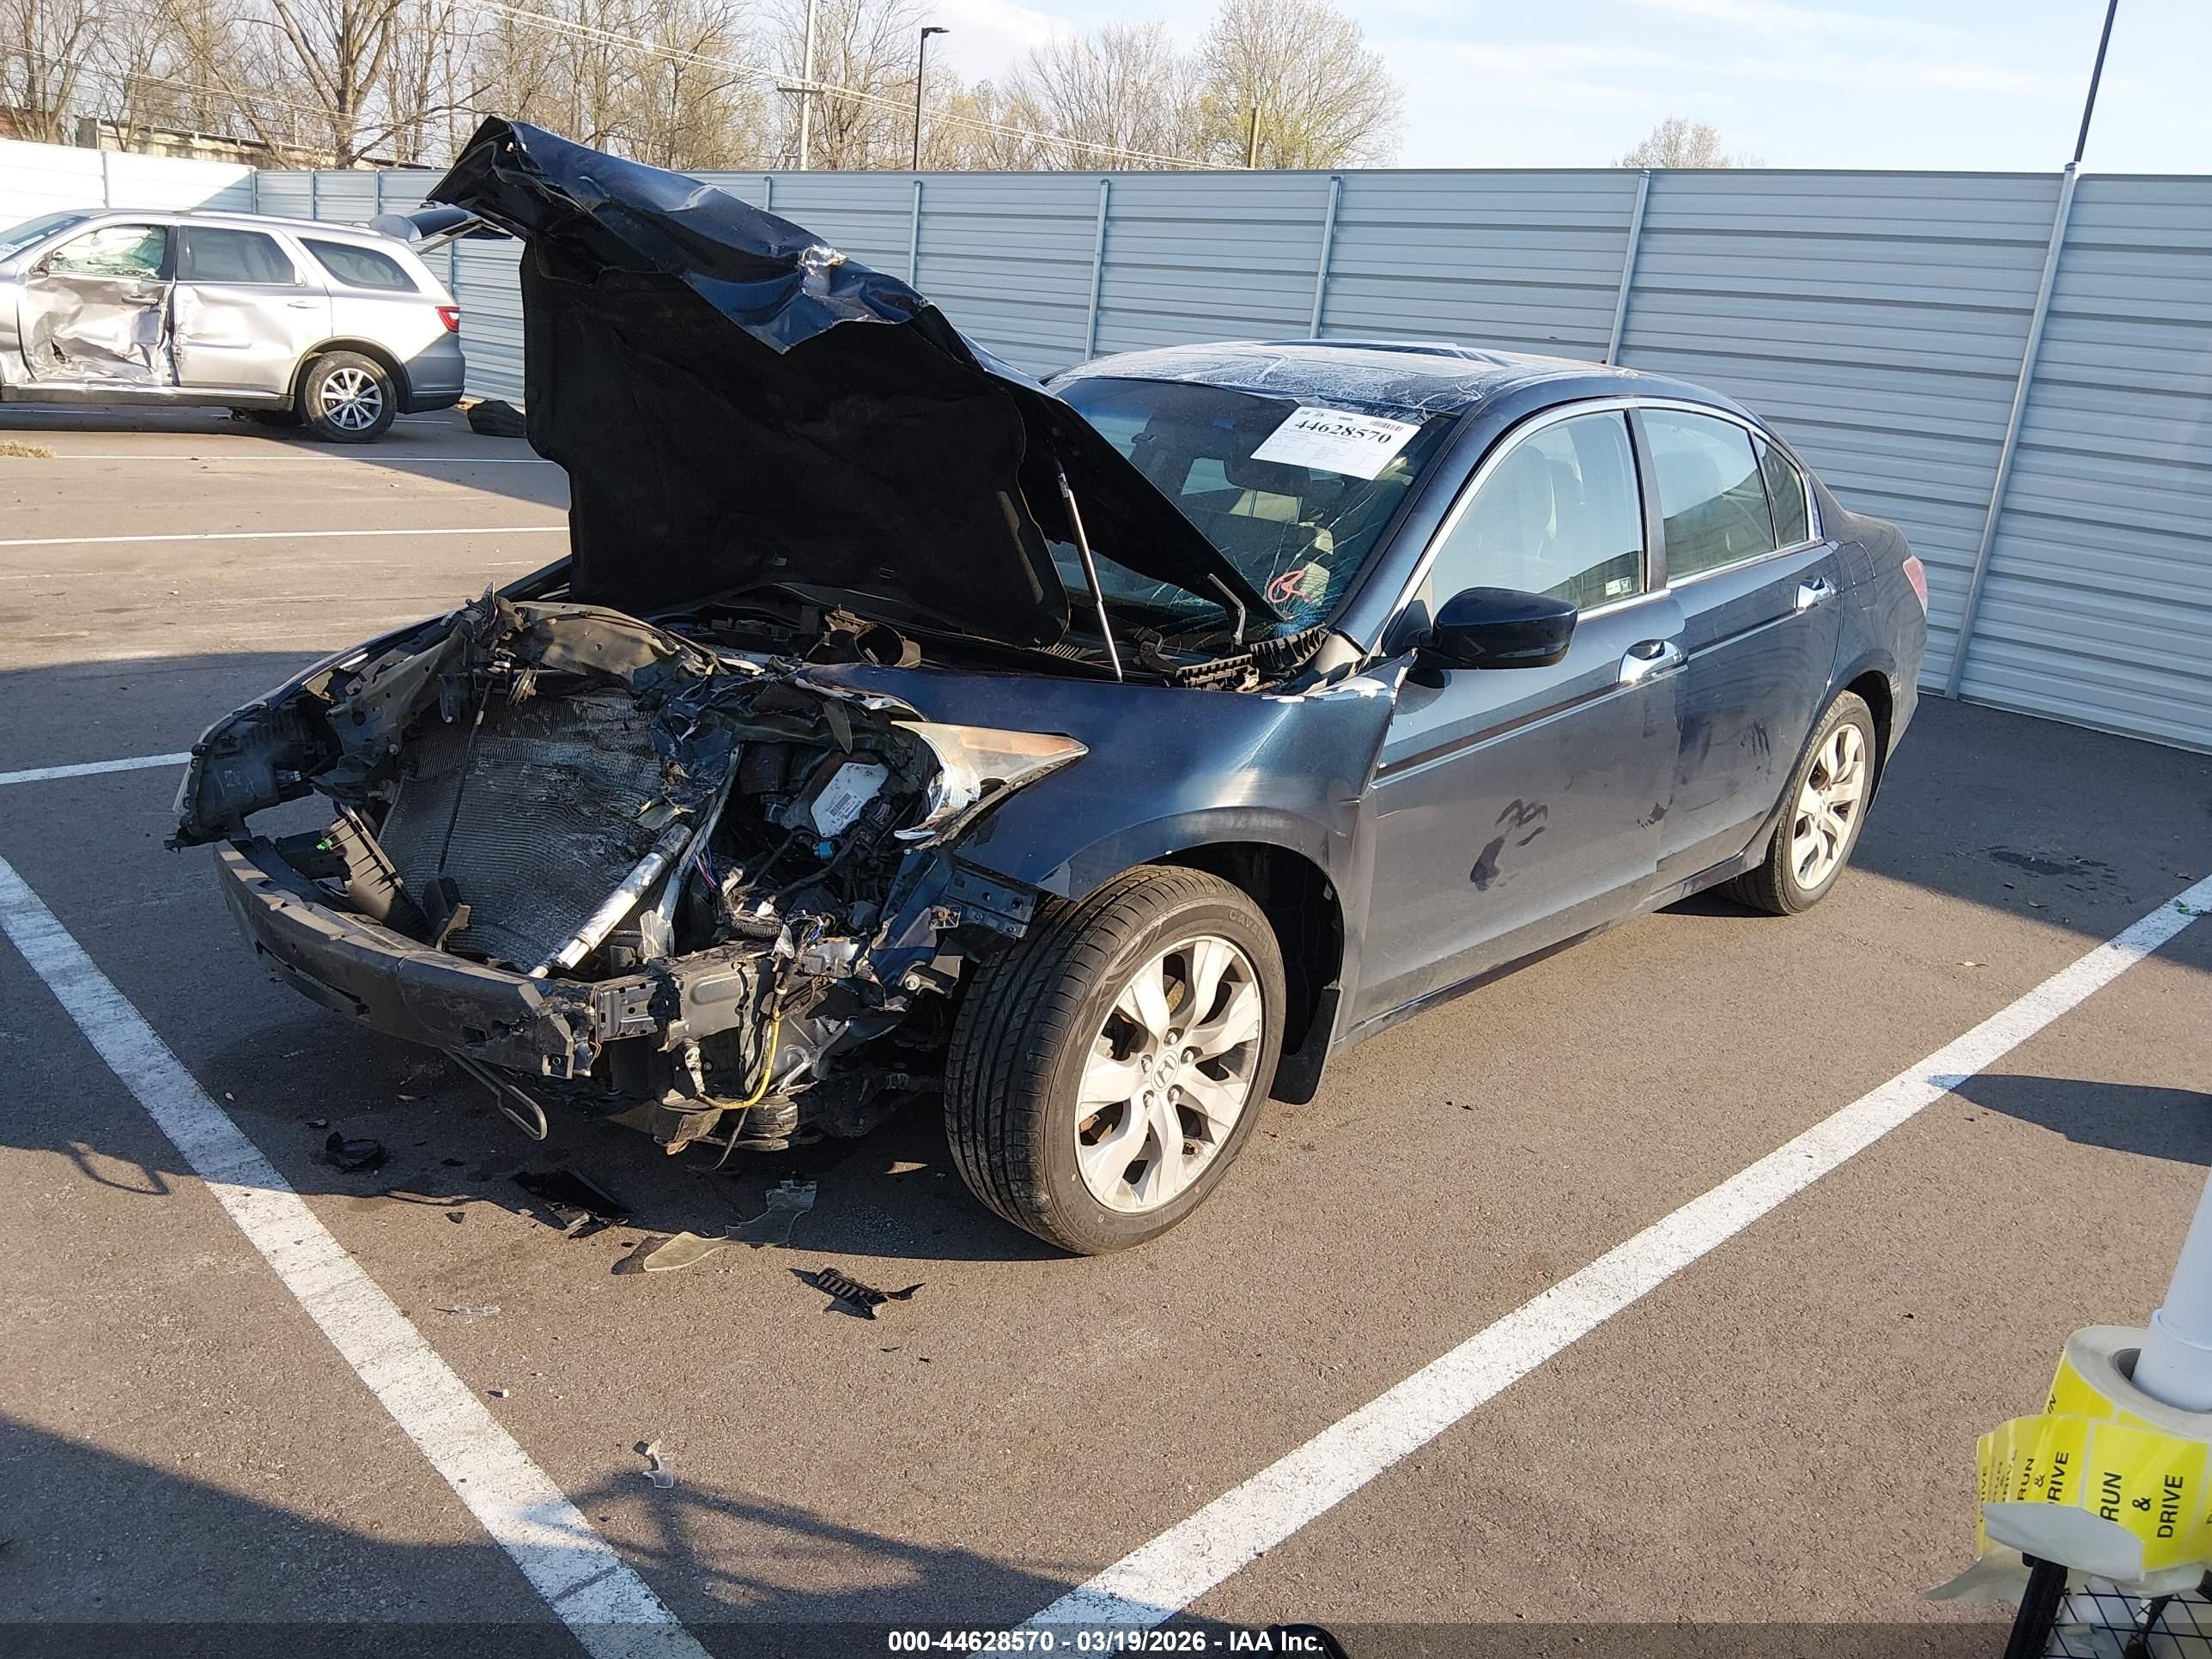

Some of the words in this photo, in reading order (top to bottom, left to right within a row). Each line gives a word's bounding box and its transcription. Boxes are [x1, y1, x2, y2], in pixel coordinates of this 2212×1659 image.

[1295, 420, 1392, 444] 44628570
[2017, 1458, 2035, 1501] RUN
[2033, 1474, 2046, 1488] &
[2047, 1451, 2069, 1504] RIVE
[2100, 1471, 2123, 1522] RUN
[2131, 1497, 2152, 1512] &
[2156, 1474, 2184, 1538] DRIVE
